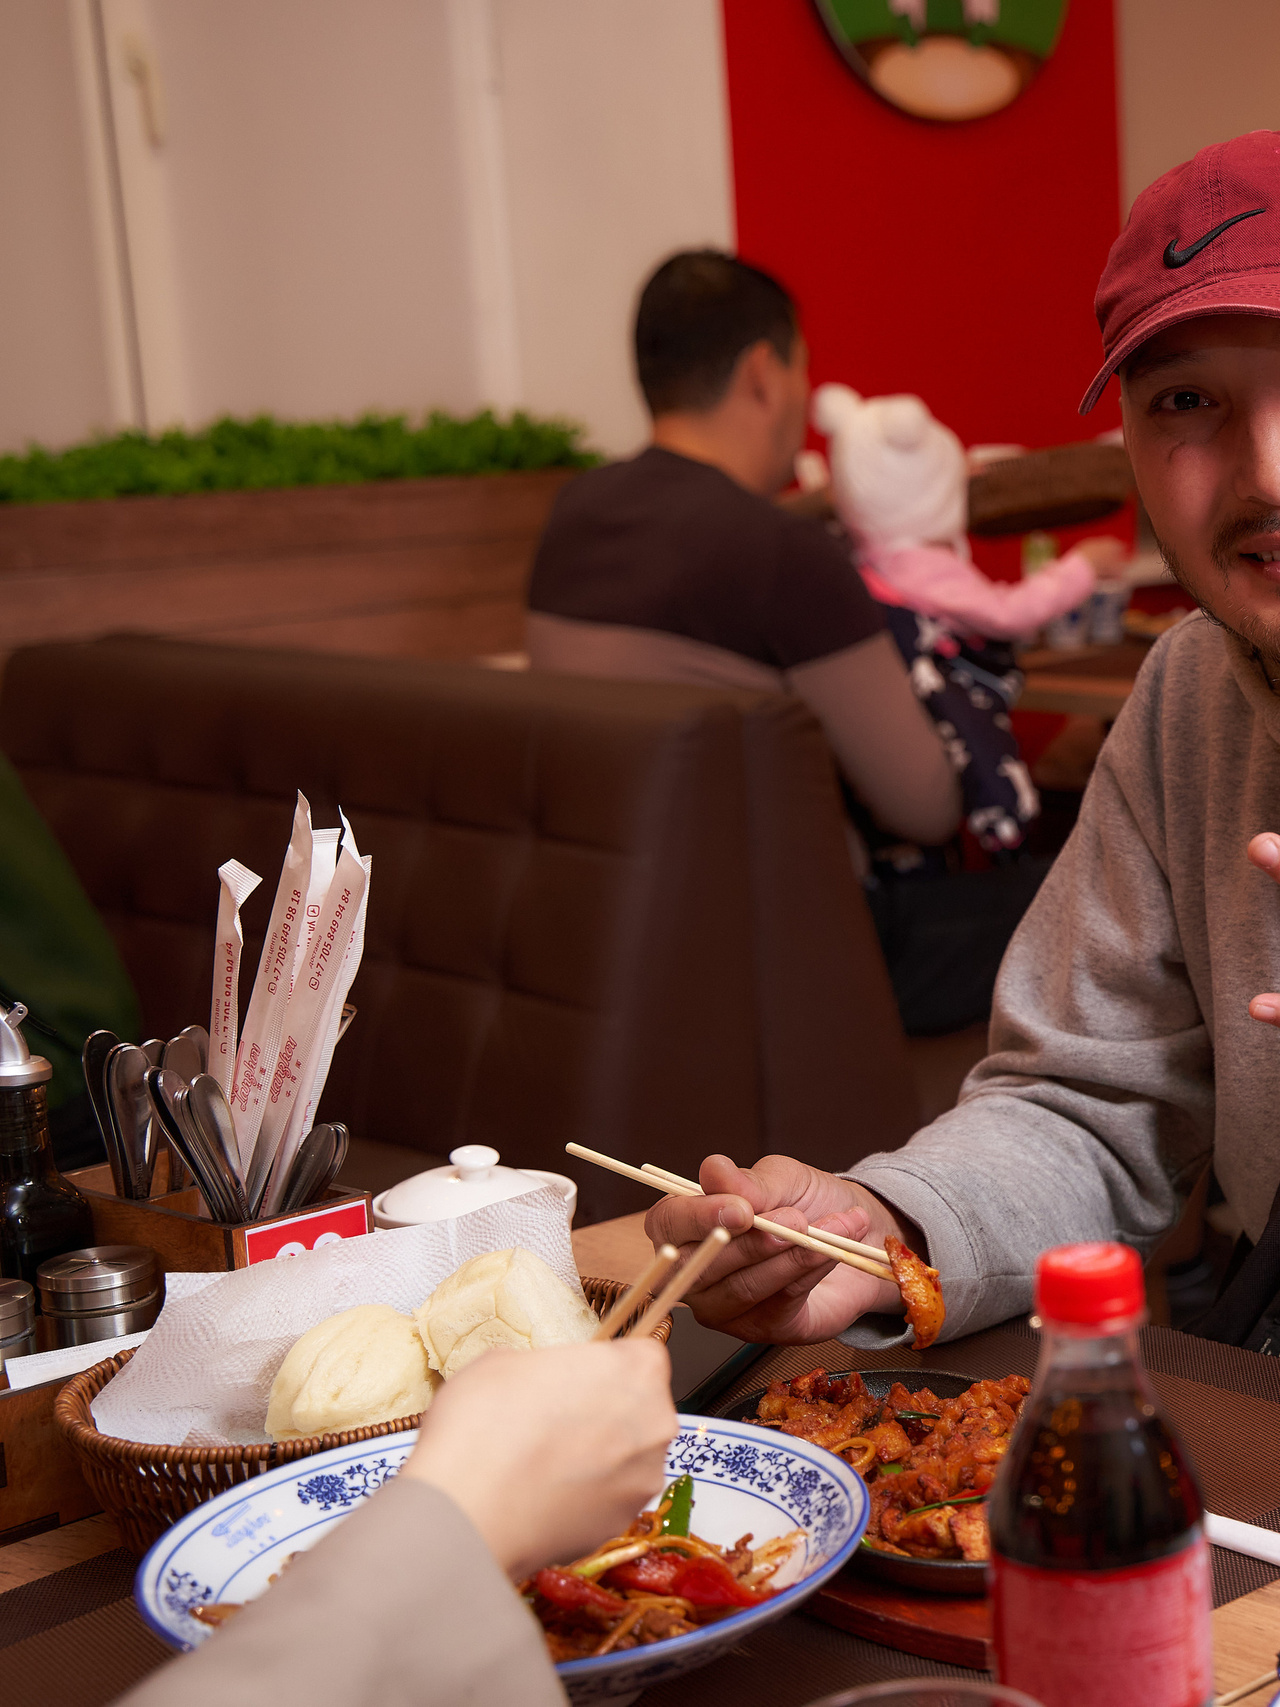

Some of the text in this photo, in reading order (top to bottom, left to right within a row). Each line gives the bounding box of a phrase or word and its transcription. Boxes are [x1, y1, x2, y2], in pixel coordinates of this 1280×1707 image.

[269, 932, 279, 954] центр
[273, 889, 302, 982] +7 705 849 98 18
[308, 935, 323, 970] доставка
[315, 888, 352, 979] +7 705 849 94 84
